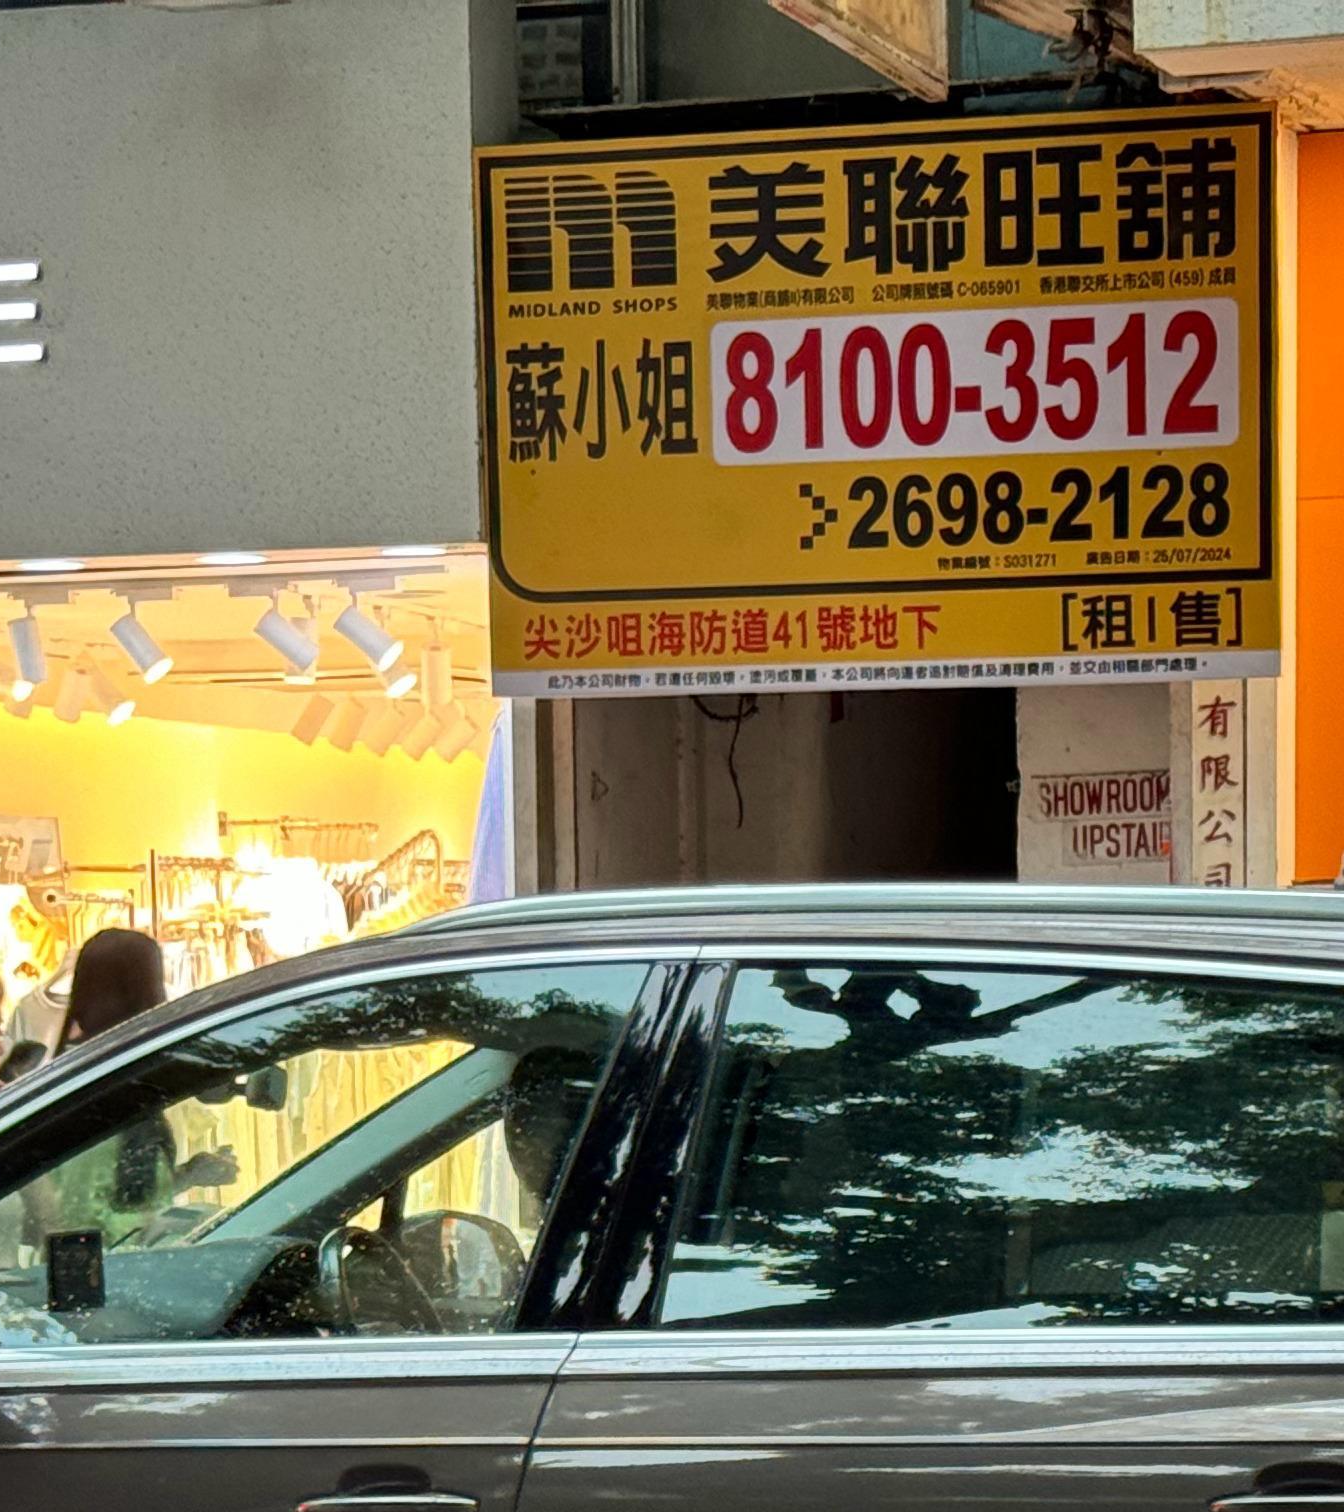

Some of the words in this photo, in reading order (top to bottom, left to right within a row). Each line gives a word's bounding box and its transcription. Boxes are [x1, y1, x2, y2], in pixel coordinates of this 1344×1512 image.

[707, 138, 1237, 282] 美聯旺舖
[508, 301, 601, 319] MIDLAND
[612, 296, 678, 315] SHOPS
[1168, 268, 1205, 288] (459)
[506, 338, 699, 462] 蘇小姐
[725, 311, 1219, 454] 8100-3512
[847, 463, 1231, 549] 2698-2128
[524, 604, 942, 660] 尖沙咀海防道41號地下
